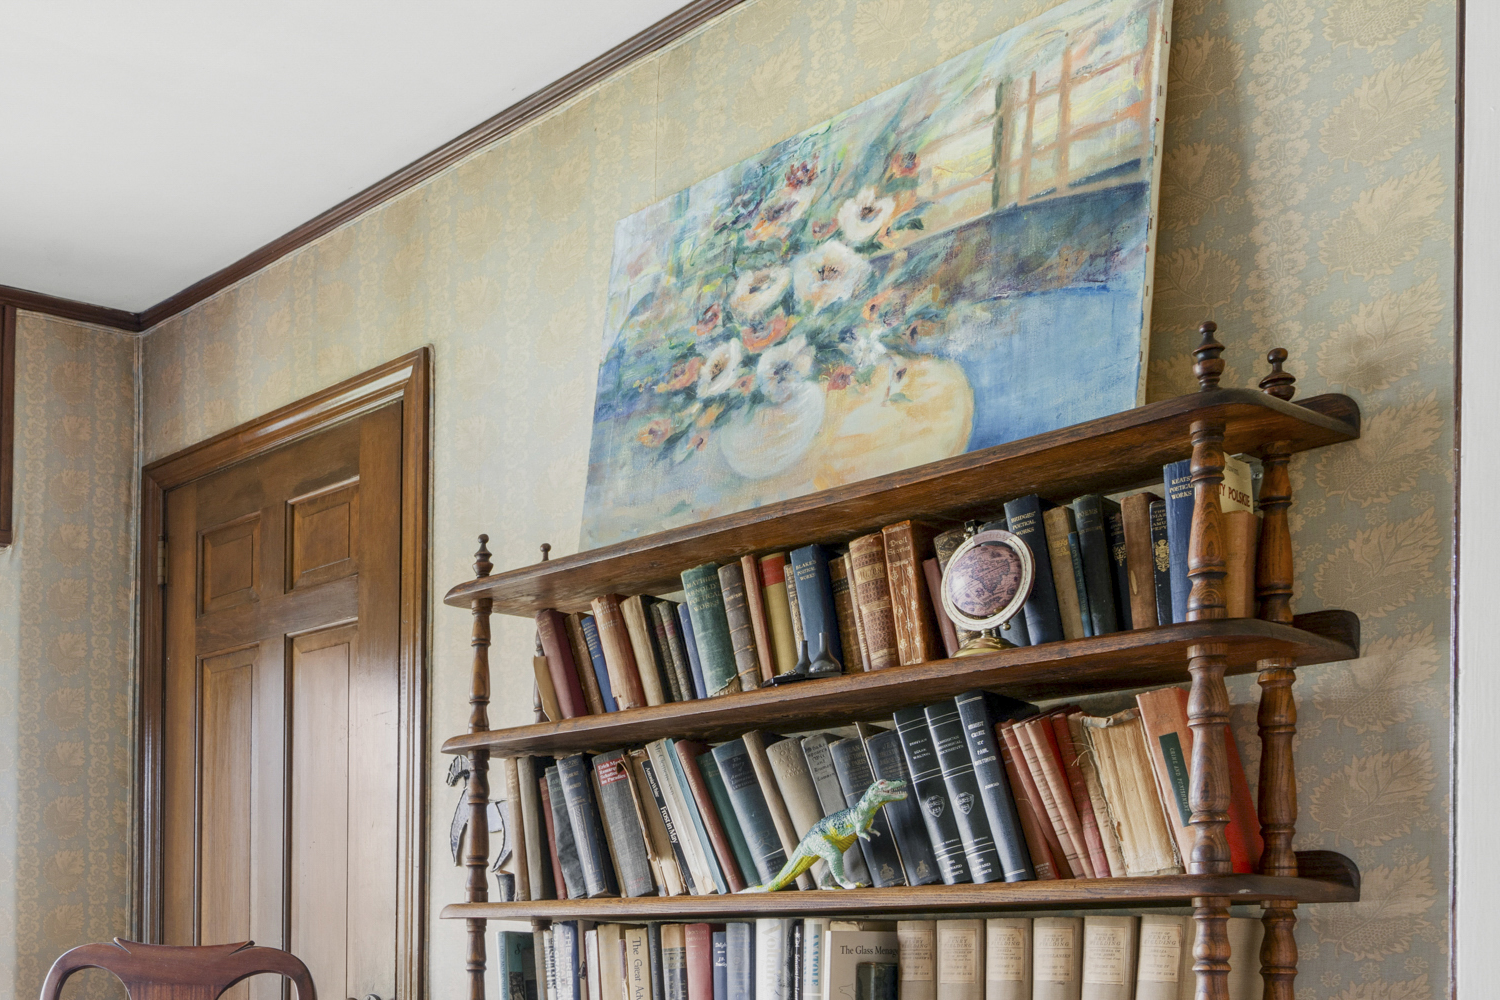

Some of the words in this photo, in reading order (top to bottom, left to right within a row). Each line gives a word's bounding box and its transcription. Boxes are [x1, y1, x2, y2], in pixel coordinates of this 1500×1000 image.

[1171, 491, 1192, 499] WORKS
[1228, 487, 1251, 507] POLSKIE
[1012, 519, 1036, 530] POETICAL
[1016, 527, 1035, 536] WORKS
[660, 806, 671, 823] Frost
[669, 827, 679, 844] May
[631, 936, 641, 955] The
[840, 945, 854, 955] The
[855, 945, 874, 955] Glass
[565, 955, 573, 1000] FRENCH
[633, 957, 643, 982] Great
